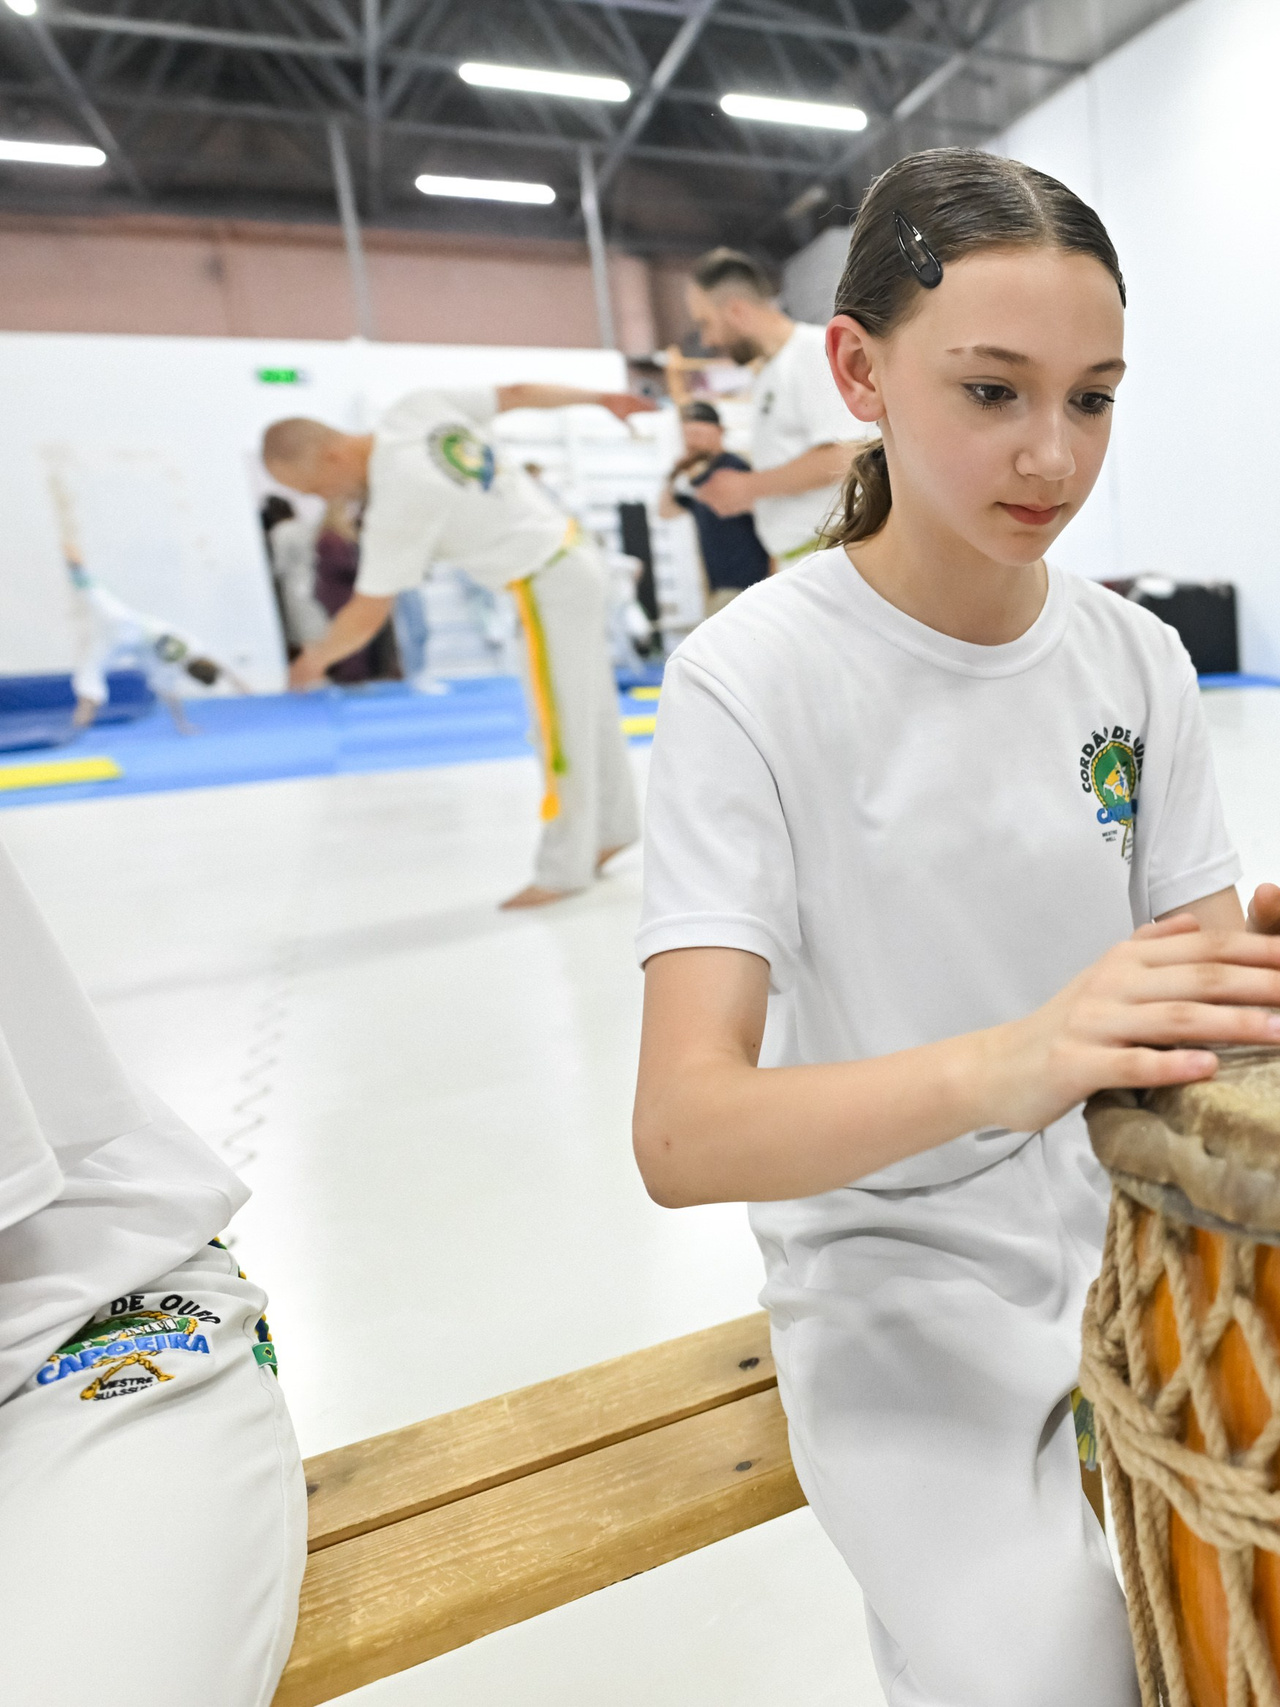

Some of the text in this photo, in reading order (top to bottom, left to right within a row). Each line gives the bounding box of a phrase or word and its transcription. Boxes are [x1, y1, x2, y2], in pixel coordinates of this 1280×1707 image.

[1111, 725, 1131, 743] DE
[110, 1294, 145, 1316] DE
[36, 1333, 211, 1386] CAPOEIRA
[99, 1376, 153, 1391] MESTRE
